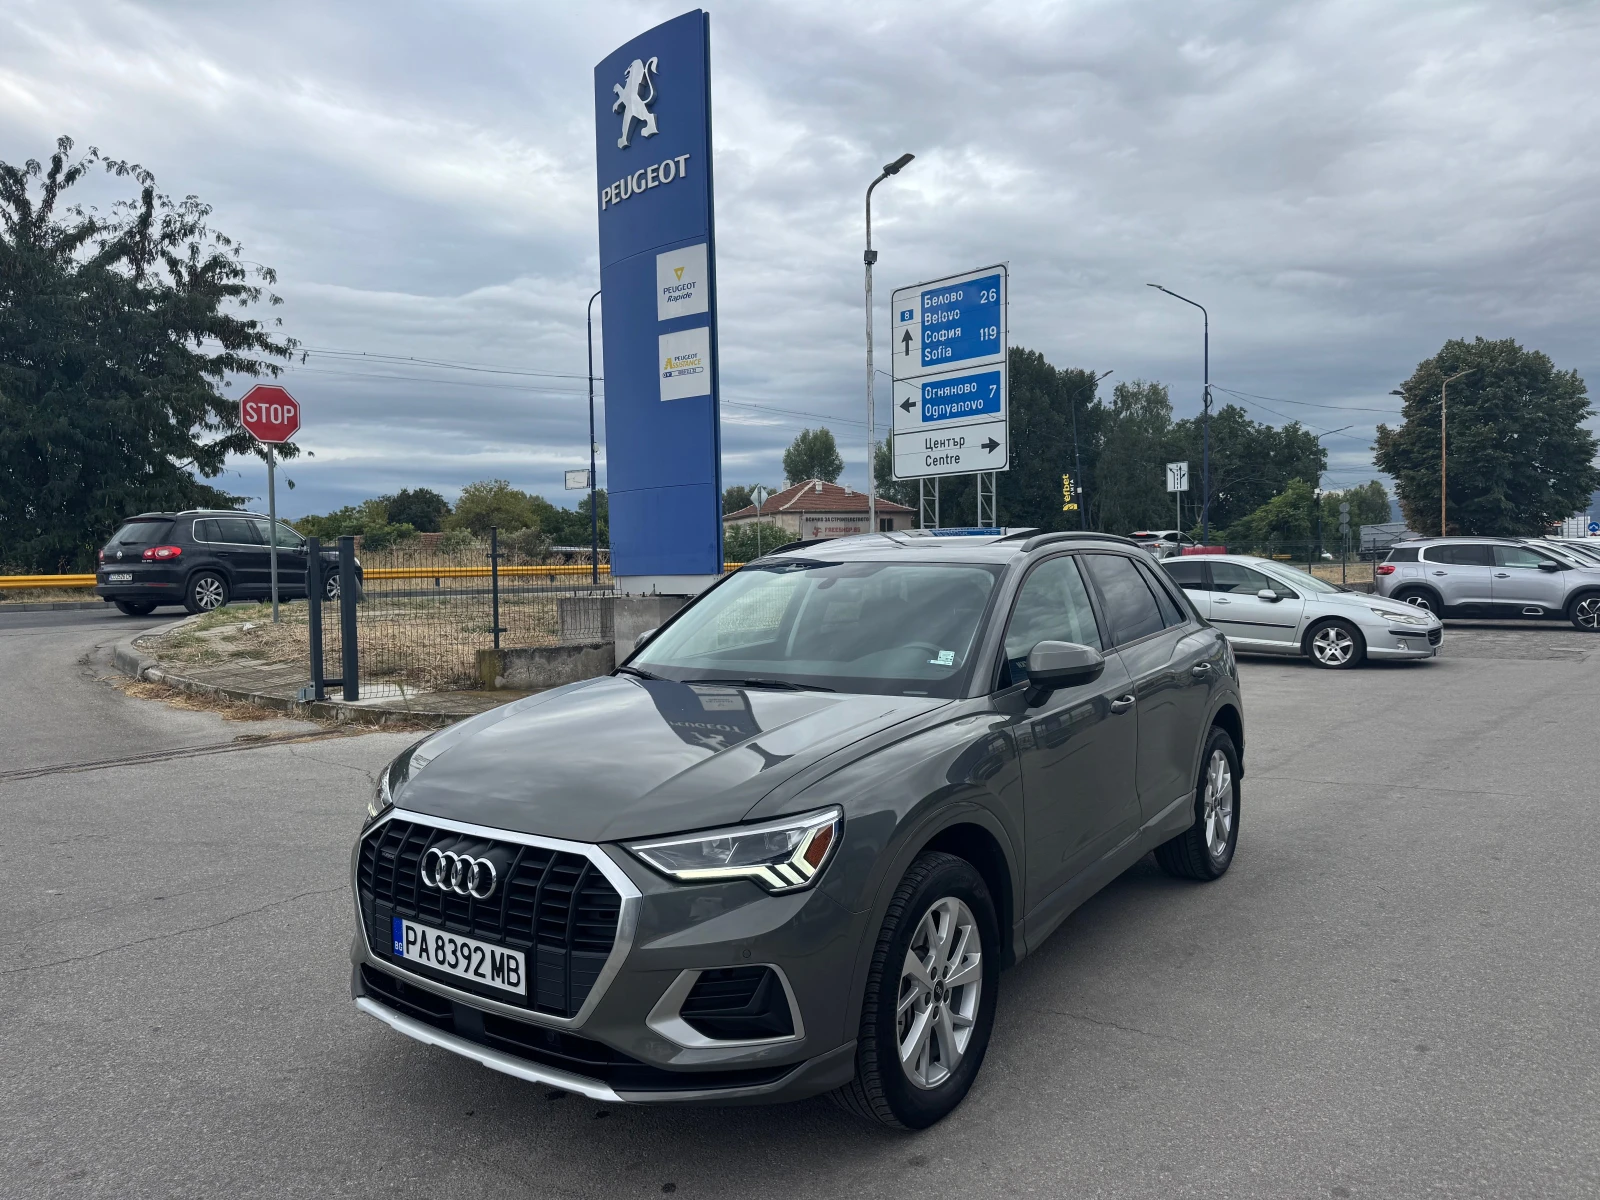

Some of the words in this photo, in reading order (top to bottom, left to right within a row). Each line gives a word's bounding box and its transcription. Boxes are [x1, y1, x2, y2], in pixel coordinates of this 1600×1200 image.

[602, 154, 690, 210] PEUGEOT
[663, 282, 696, 295] PEUGEOT
[666, 292, 693, 303] Rapide
[924, 290, 964, 308] Белово
[980, 288, 997, 304] 26
[904, 312, 910, 320] 8
[924, 308, 960, 326] Belovo
[924, 327, 962, 344] София
[979, 326, 997, 342] 119
[674, 352, 698, 362] PEUGEOT
[924, 346, 952, 361] Sofia
[925, 382, 977, 400] Огняново
[989, 384, 997, 398] 7
[246, 402, 295, 424] STOP
[925, 398, 984, 418] Ognyanovo
[925, 436, 966, 452] Център
[925, 453, 961, 467] Centre
[1062, 474, 1071, 502] efbet
[394, 941, 403, 952] BG
